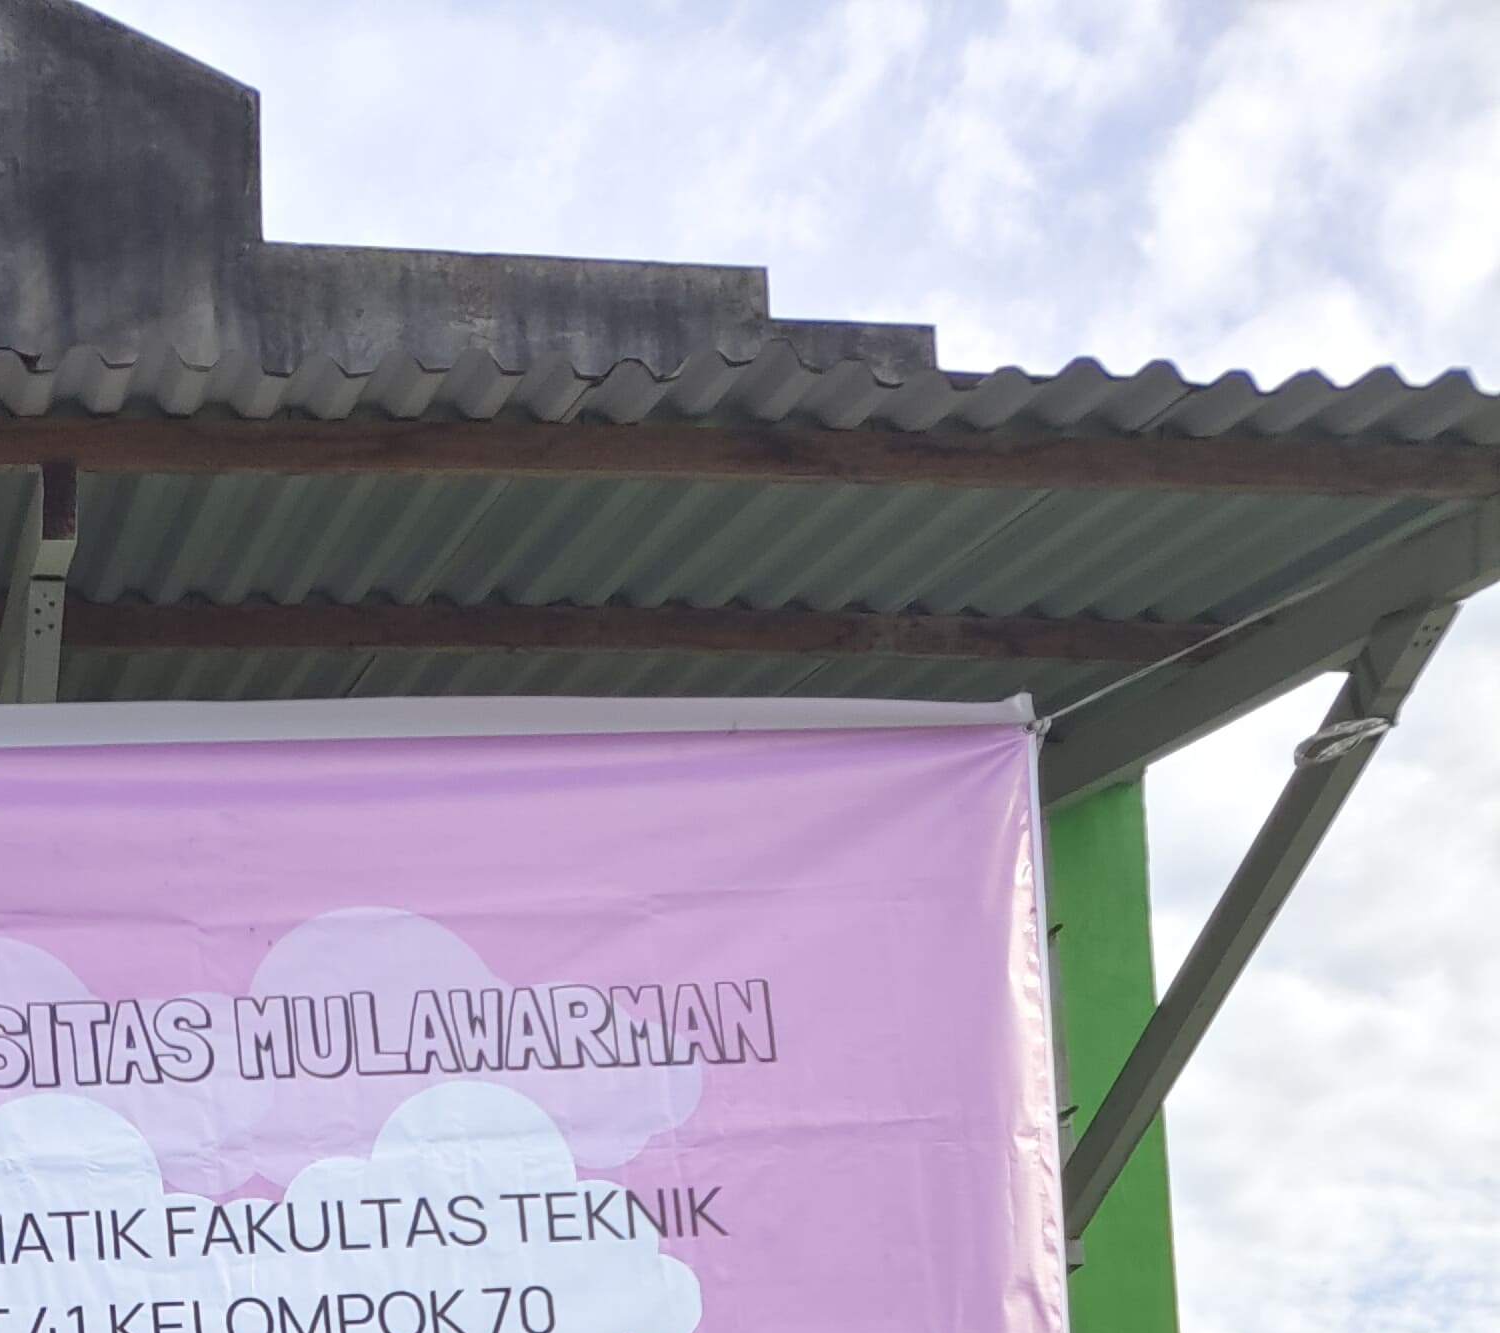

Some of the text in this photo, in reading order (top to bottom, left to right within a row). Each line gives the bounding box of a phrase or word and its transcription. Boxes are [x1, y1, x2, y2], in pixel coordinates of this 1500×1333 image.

[234, 979, 777, 1080] MULAWARMAN
[165, 1194, 489, 1258] FAKULTAS
[500, 1186, 730, 1244] TEKNIK
